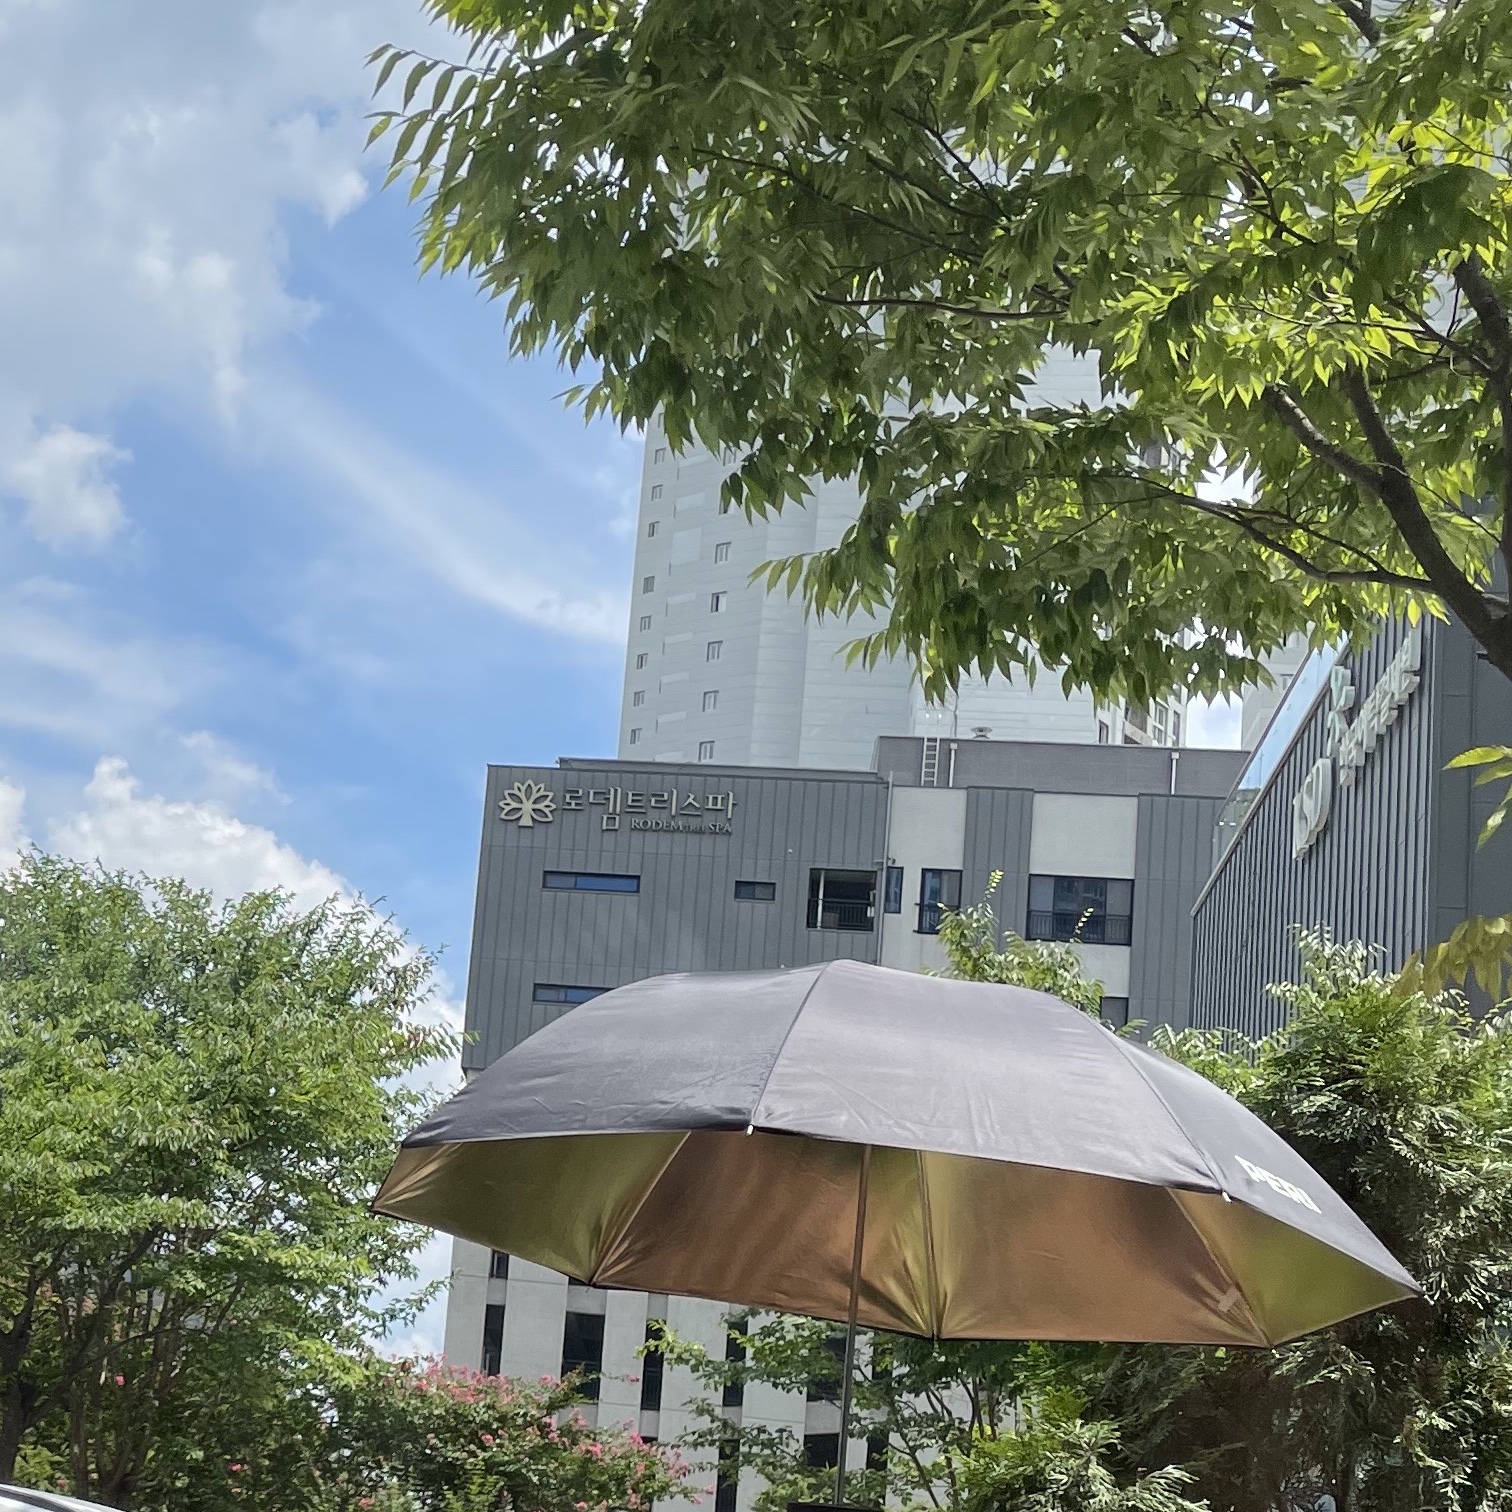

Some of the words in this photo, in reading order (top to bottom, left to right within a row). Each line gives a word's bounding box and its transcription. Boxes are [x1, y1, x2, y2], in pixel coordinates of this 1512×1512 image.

[562, 786, 738, 831] 로뎀트리스파
[631, 817, 683, 832] RODEM
[708, 822, 733, 834] SPA
[1234, 1154, 1323, 1215] PERI
